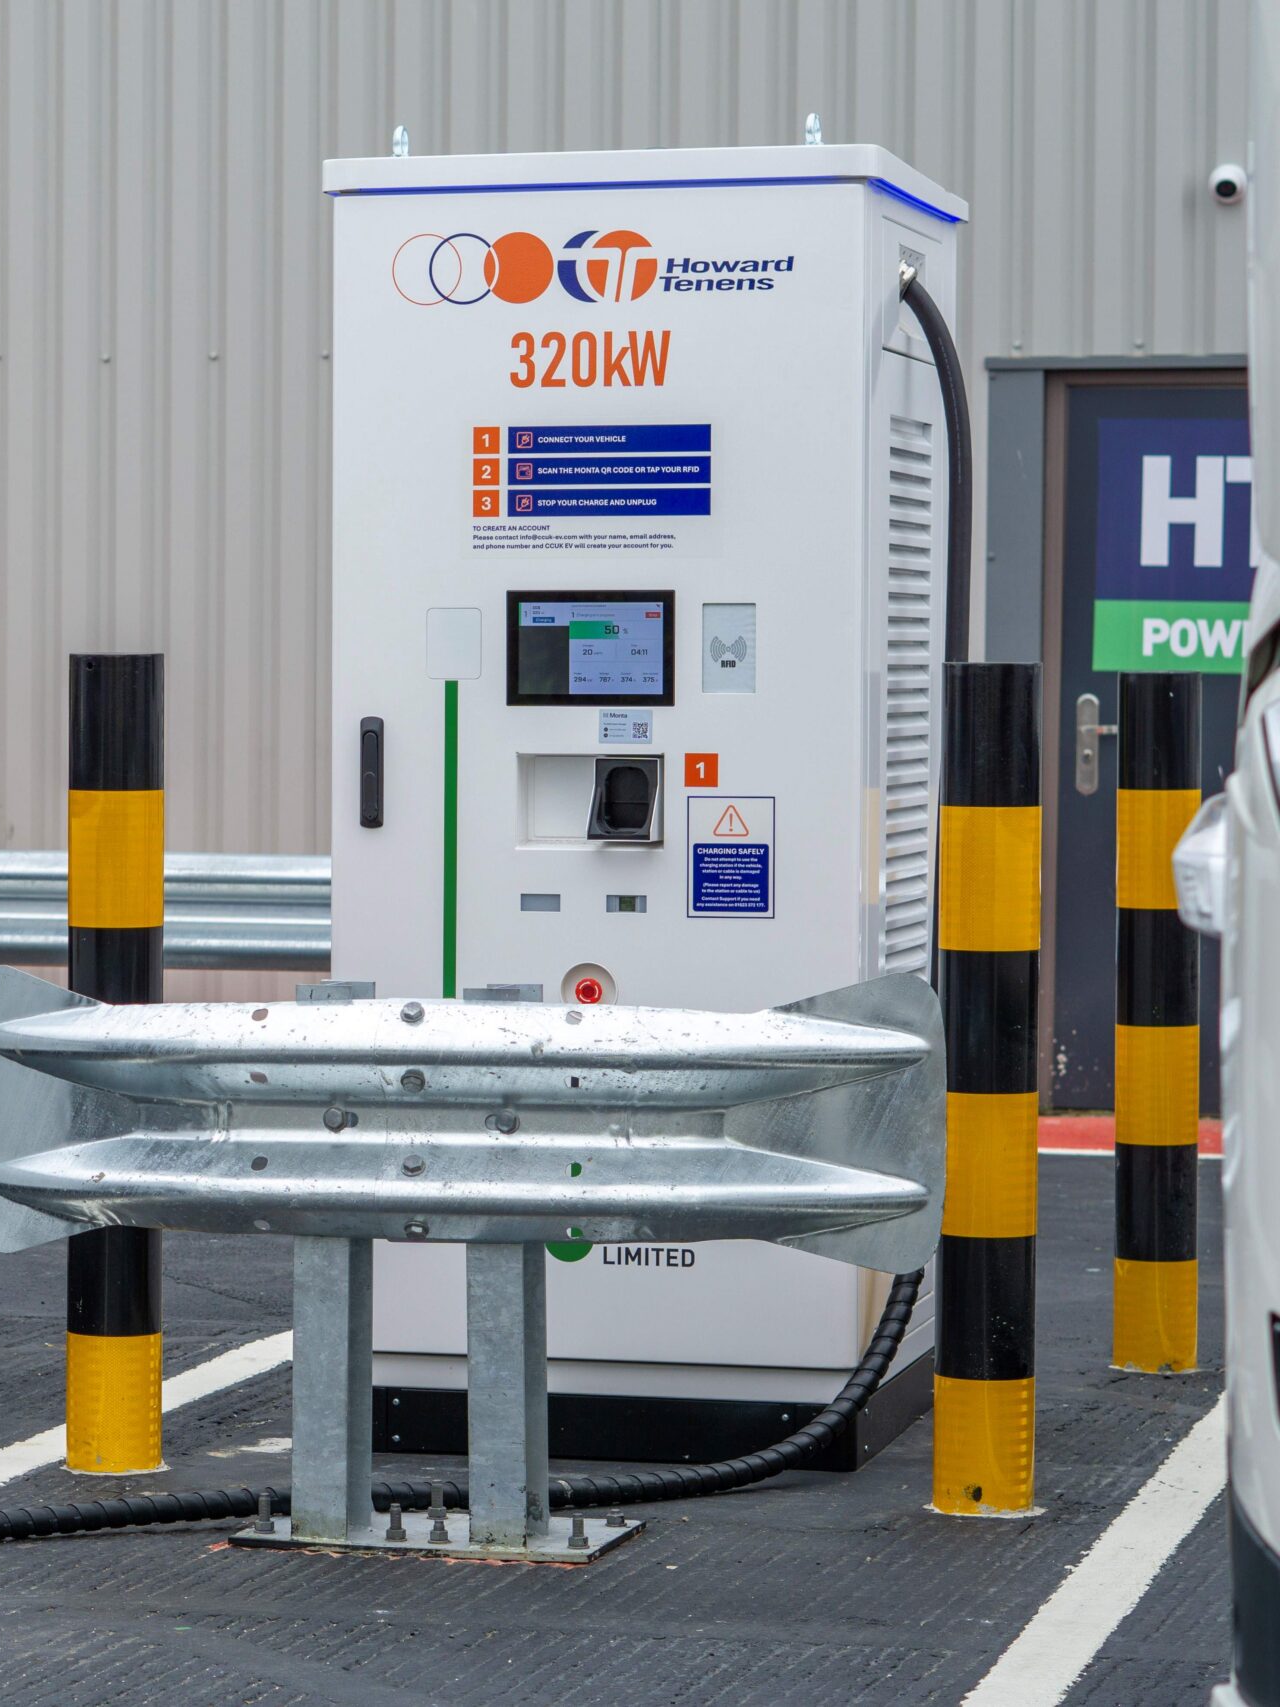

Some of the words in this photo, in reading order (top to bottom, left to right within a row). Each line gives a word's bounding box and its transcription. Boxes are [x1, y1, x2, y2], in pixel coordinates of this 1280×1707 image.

[666, 255, 795, 274] Howard
[659, 275, 774, 292] Tenens
[510, 330, 671, 388] 320kW
[481, 434, 490, 447] 1
[595, 435, 626, 443] VEHICLE
[481, 465, 491, 479] 2
[601, 466, 612, 474] QR
[481, 497, 491, 510] 3
[537, 499, 556, 507] STOP
[627, 498, 657, 506] UNPLUG
[604, 625, 620, 635] 50
[1142, 617, 1250, 658] POW
[721, 660, 736, 668] RFID
[696, 762, 705, 779] 1
[603, 1246, 695, 1267] LIMITED
